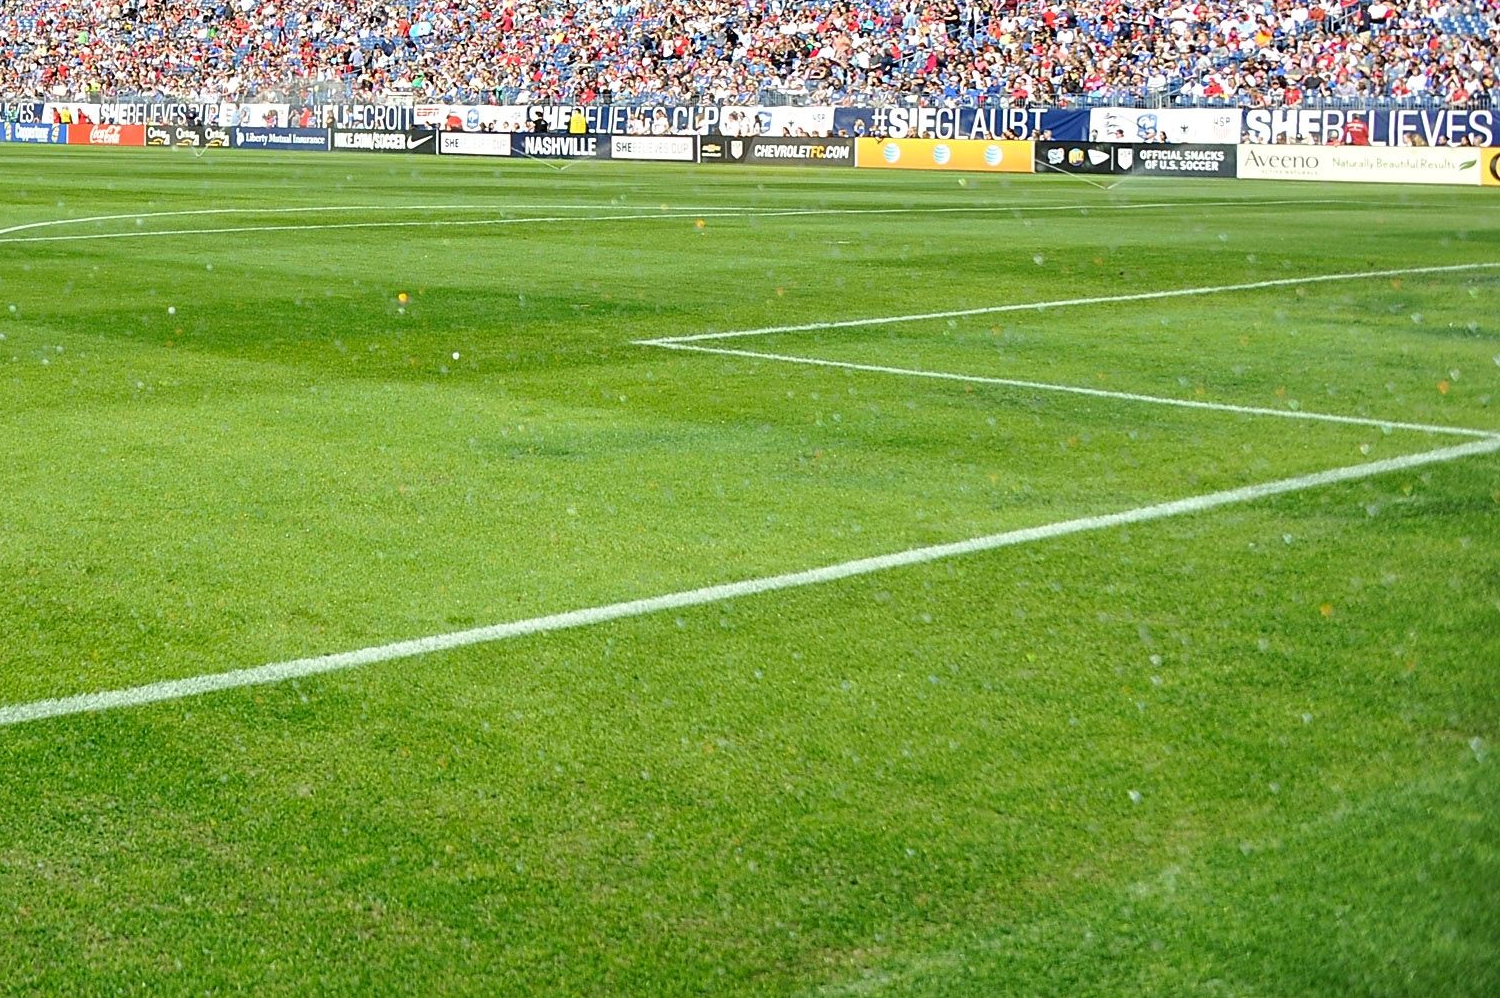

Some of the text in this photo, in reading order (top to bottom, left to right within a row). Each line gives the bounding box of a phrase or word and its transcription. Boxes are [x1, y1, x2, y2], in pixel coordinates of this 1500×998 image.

[417, 108, 440, 117] ESPN
[872, 107, 1048, 140] #SIEGLAUBT
[1246, 109, 1493, 147] SHEBELIEVES
[246, 132, 326, 145] Liberty Mutual Insurance
[334, 132, 407, 150] NIKE.COM/SOCCER
[525, 136, 597, 155] NASHVILLE
[754, 145, 850, 159] CHEVROLETFC.COM
[1139, 150, 1225, 161] OFFICIAL SNACKS
[1145, 160, 1219, 171] OF U.S. SOCCER
[1245, 150, 1319, 169] Aveeno
[1332, 157, 1457, 171] Naturally Beautiful Results
